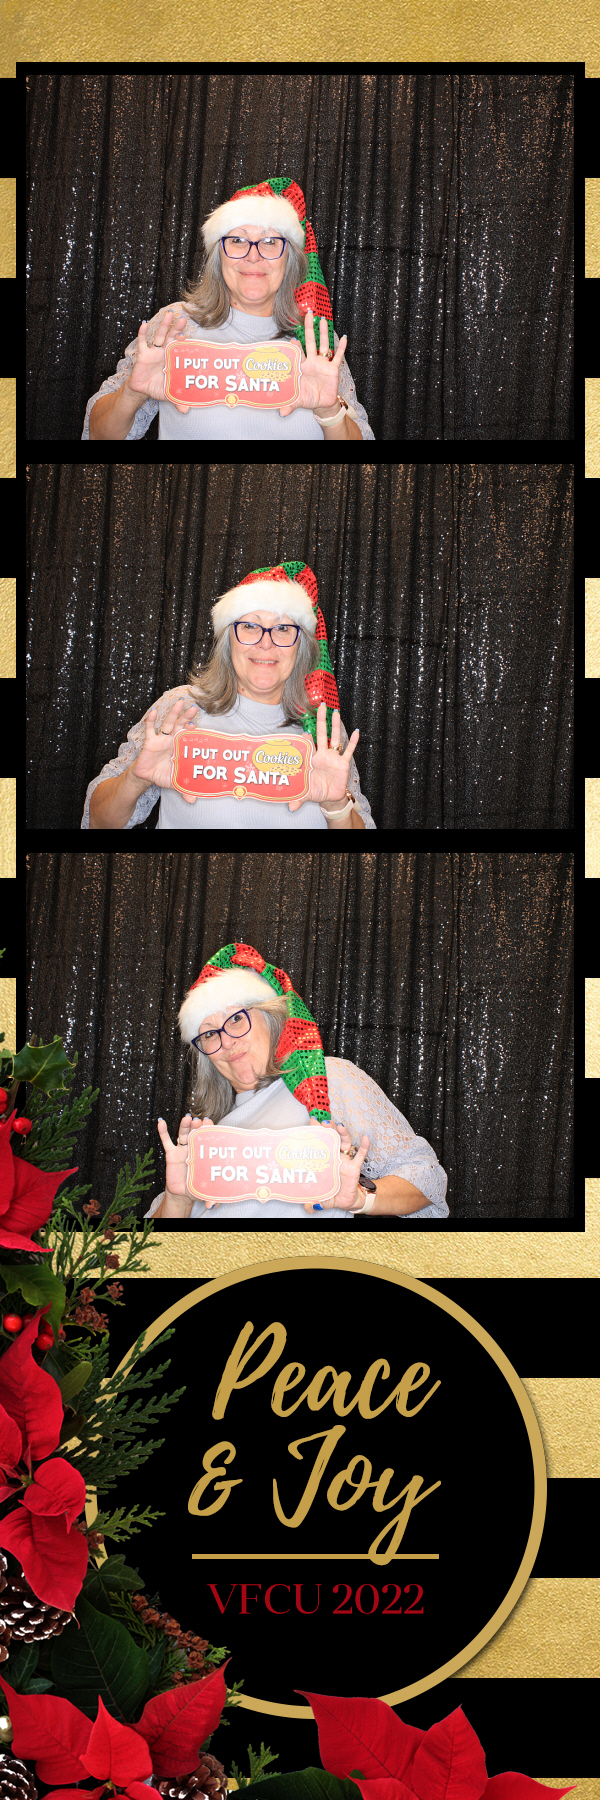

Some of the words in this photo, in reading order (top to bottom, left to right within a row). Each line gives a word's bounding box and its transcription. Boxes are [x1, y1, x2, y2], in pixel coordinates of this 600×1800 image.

[175, 356, 180, 369] I
[184, 358, 209, 370] PUT
[213, 358, 240, 370] OUT
[245, 358, 290, 371] Cookies
[185, 375, 220, 390] FOR
[184, 745, 188, 759] I
[192, 748, 218, 760] PUT
[223, 749, 250, 762] OUT
[255, 750, 301, 766] Cookies
[192, 765, 228, 781] FOR
[200, 1145, 204, 1159] I
[208, 1146, 237, 1159] PUT
[242, 1146, 272, 1159] OUT
[278, 1145, 328, 1160] Cookies
[210, 1166, 249, 1182] FOR
